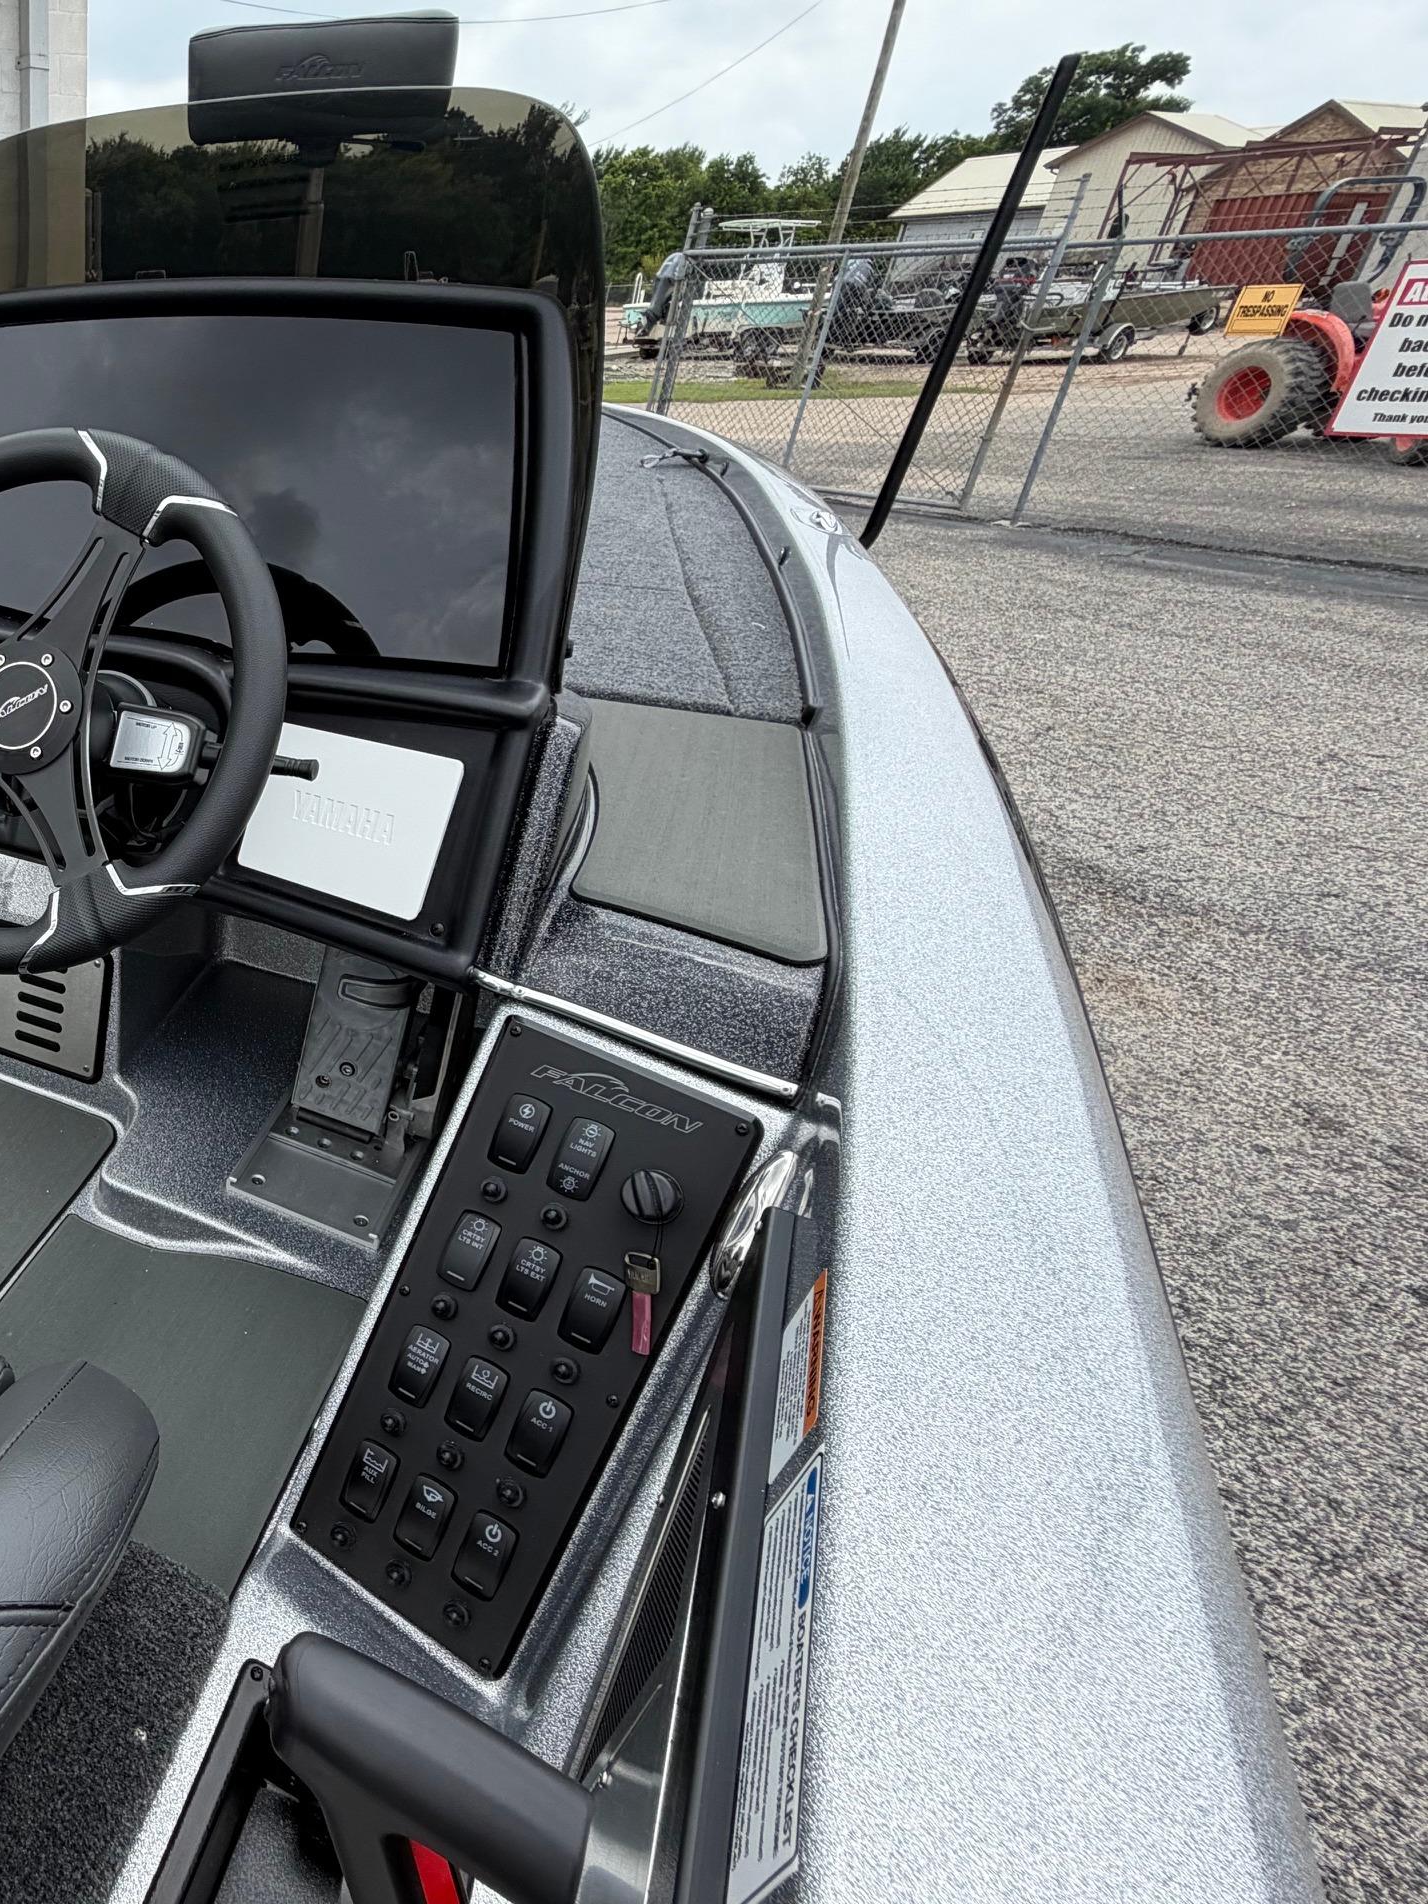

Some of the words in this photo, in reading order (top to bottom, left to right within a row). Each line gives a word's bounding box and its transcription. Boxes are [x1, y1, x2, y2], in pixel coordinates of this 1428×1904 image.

[1262, 289, 1276, 303] NO
[1236, 304, 1290, 318] TRESPASSING
[1388, 312, 1414, 328] Do
[1372, 412, 1408, 423] Thank
[292, 789, 395, 846] YAMAHA
[530, 1064, 704, 1134] FALCON
[508, 1116, 536, 1133] POWER
[568, 1144, 598, 1158] LIGHTS
[577, 1137, 596, 1149] NAV
[557, 1162, 591, 1181] ANCHOR
[457, 1234, 471, 1246] LTS
[470, 1239, 484, 1251] INT
[462, 1228, 487, 1243] CRTSY
[515, 1264, 530, 1276] LTS
[529, 1269, 546, 1282] EXT
[520, 1258, 546, 1274] CRTSY
[584, 1292, 608, 1308] HORN
[406, 1353, 424, 1367] AUTO
[408, 1344, 440, 1365] AERATOR
[407, 1361, 423, 1373] MAN
[806, 1312, 822, 1418] WARNING
[465, 1382, 494, 1401] RECIRC
[530, 1416, 548, 1431] ACC
[548, 1425, 554, 1434] 1
[360, 1471, 376, 1485] FILL
[363, 1465, 378, 1478] AUX
[415, 1501, 438, 1519] BILGE
[476, 1539, 493, 1553] ACC
[492, 1549, 500, 1558] 2
[800, 1512, 815, 1585] NOTICE
[790, 1609, 808, 1716] BOATER'S
[781, 1715, 800, 1847] CHECKLIST
